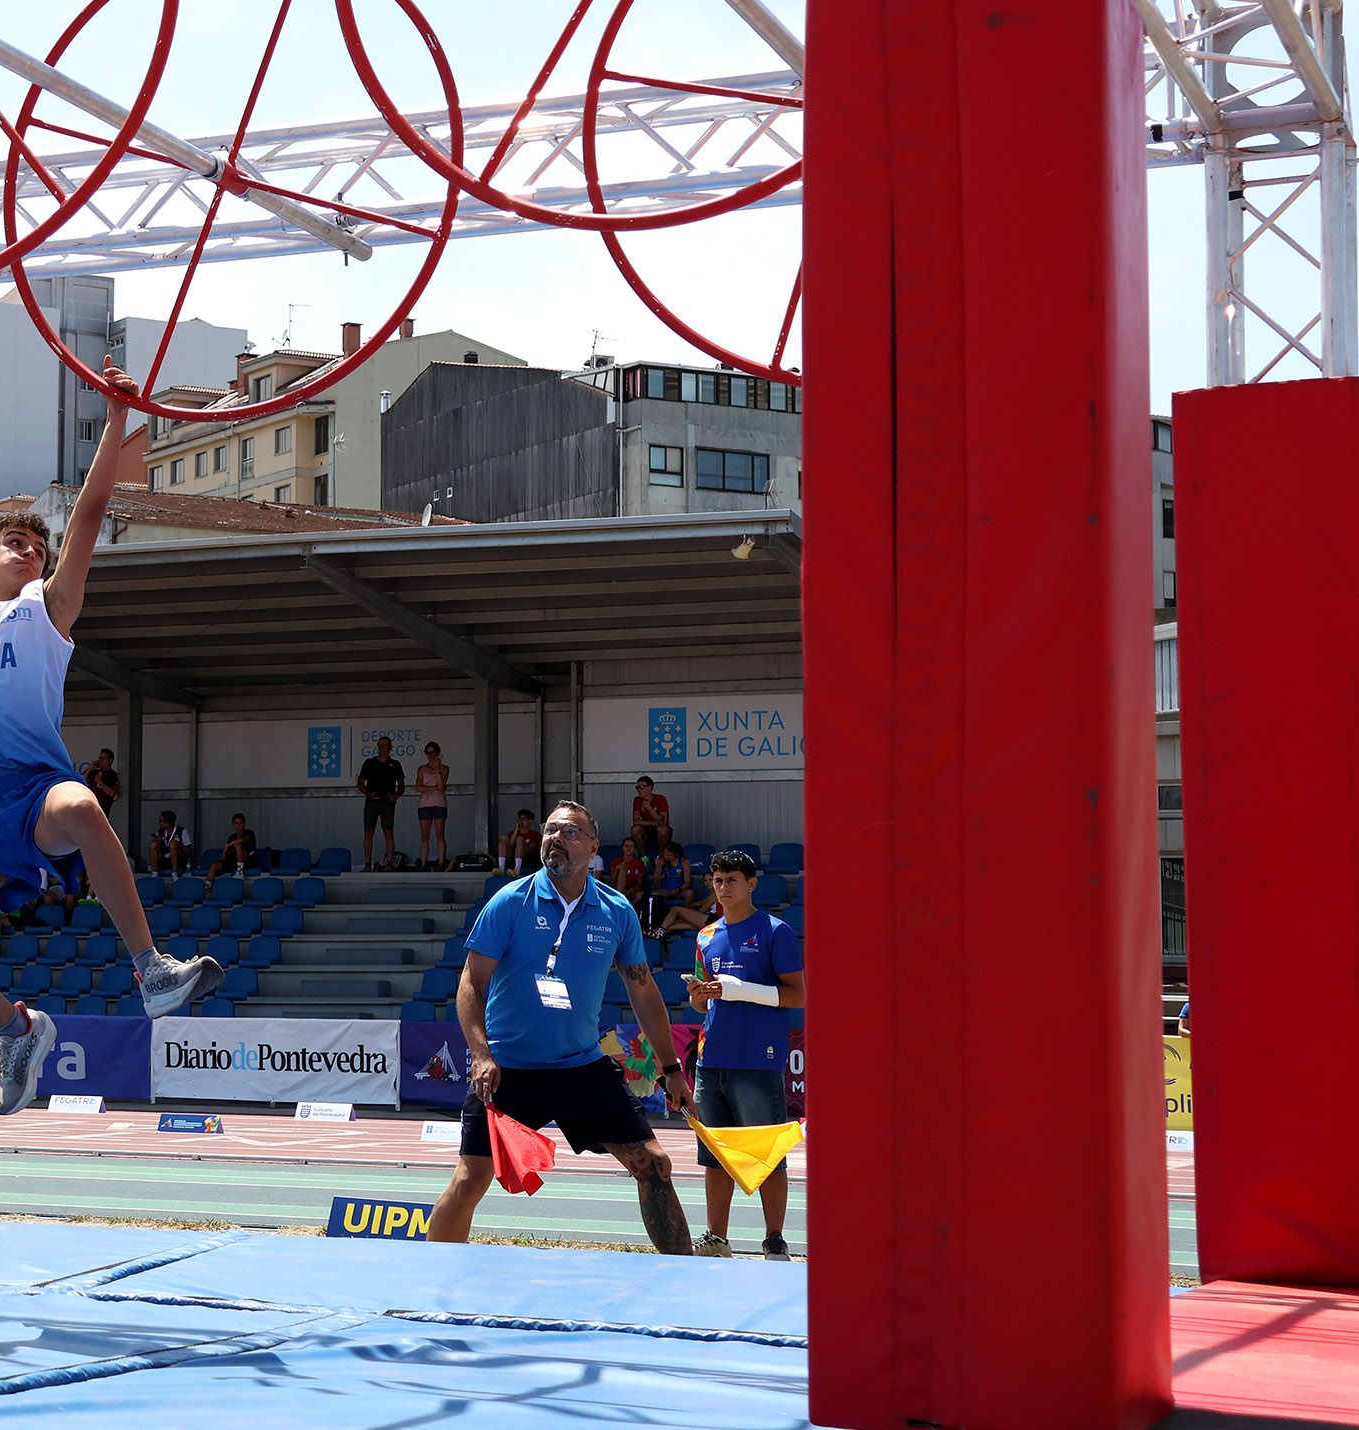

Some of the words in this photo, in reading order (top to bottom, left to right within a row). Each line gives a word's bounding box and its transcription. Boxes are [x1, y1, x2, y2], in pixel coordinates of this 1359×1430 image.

[697, 710, 785, 731] XUNTA
[361, 729, 421, 742] DEPORTE
[696, 737, 728, 757] DE
[14, 1031, 38, 1086] BROOKS
[343, 1203, 432, 1238] UIPM
